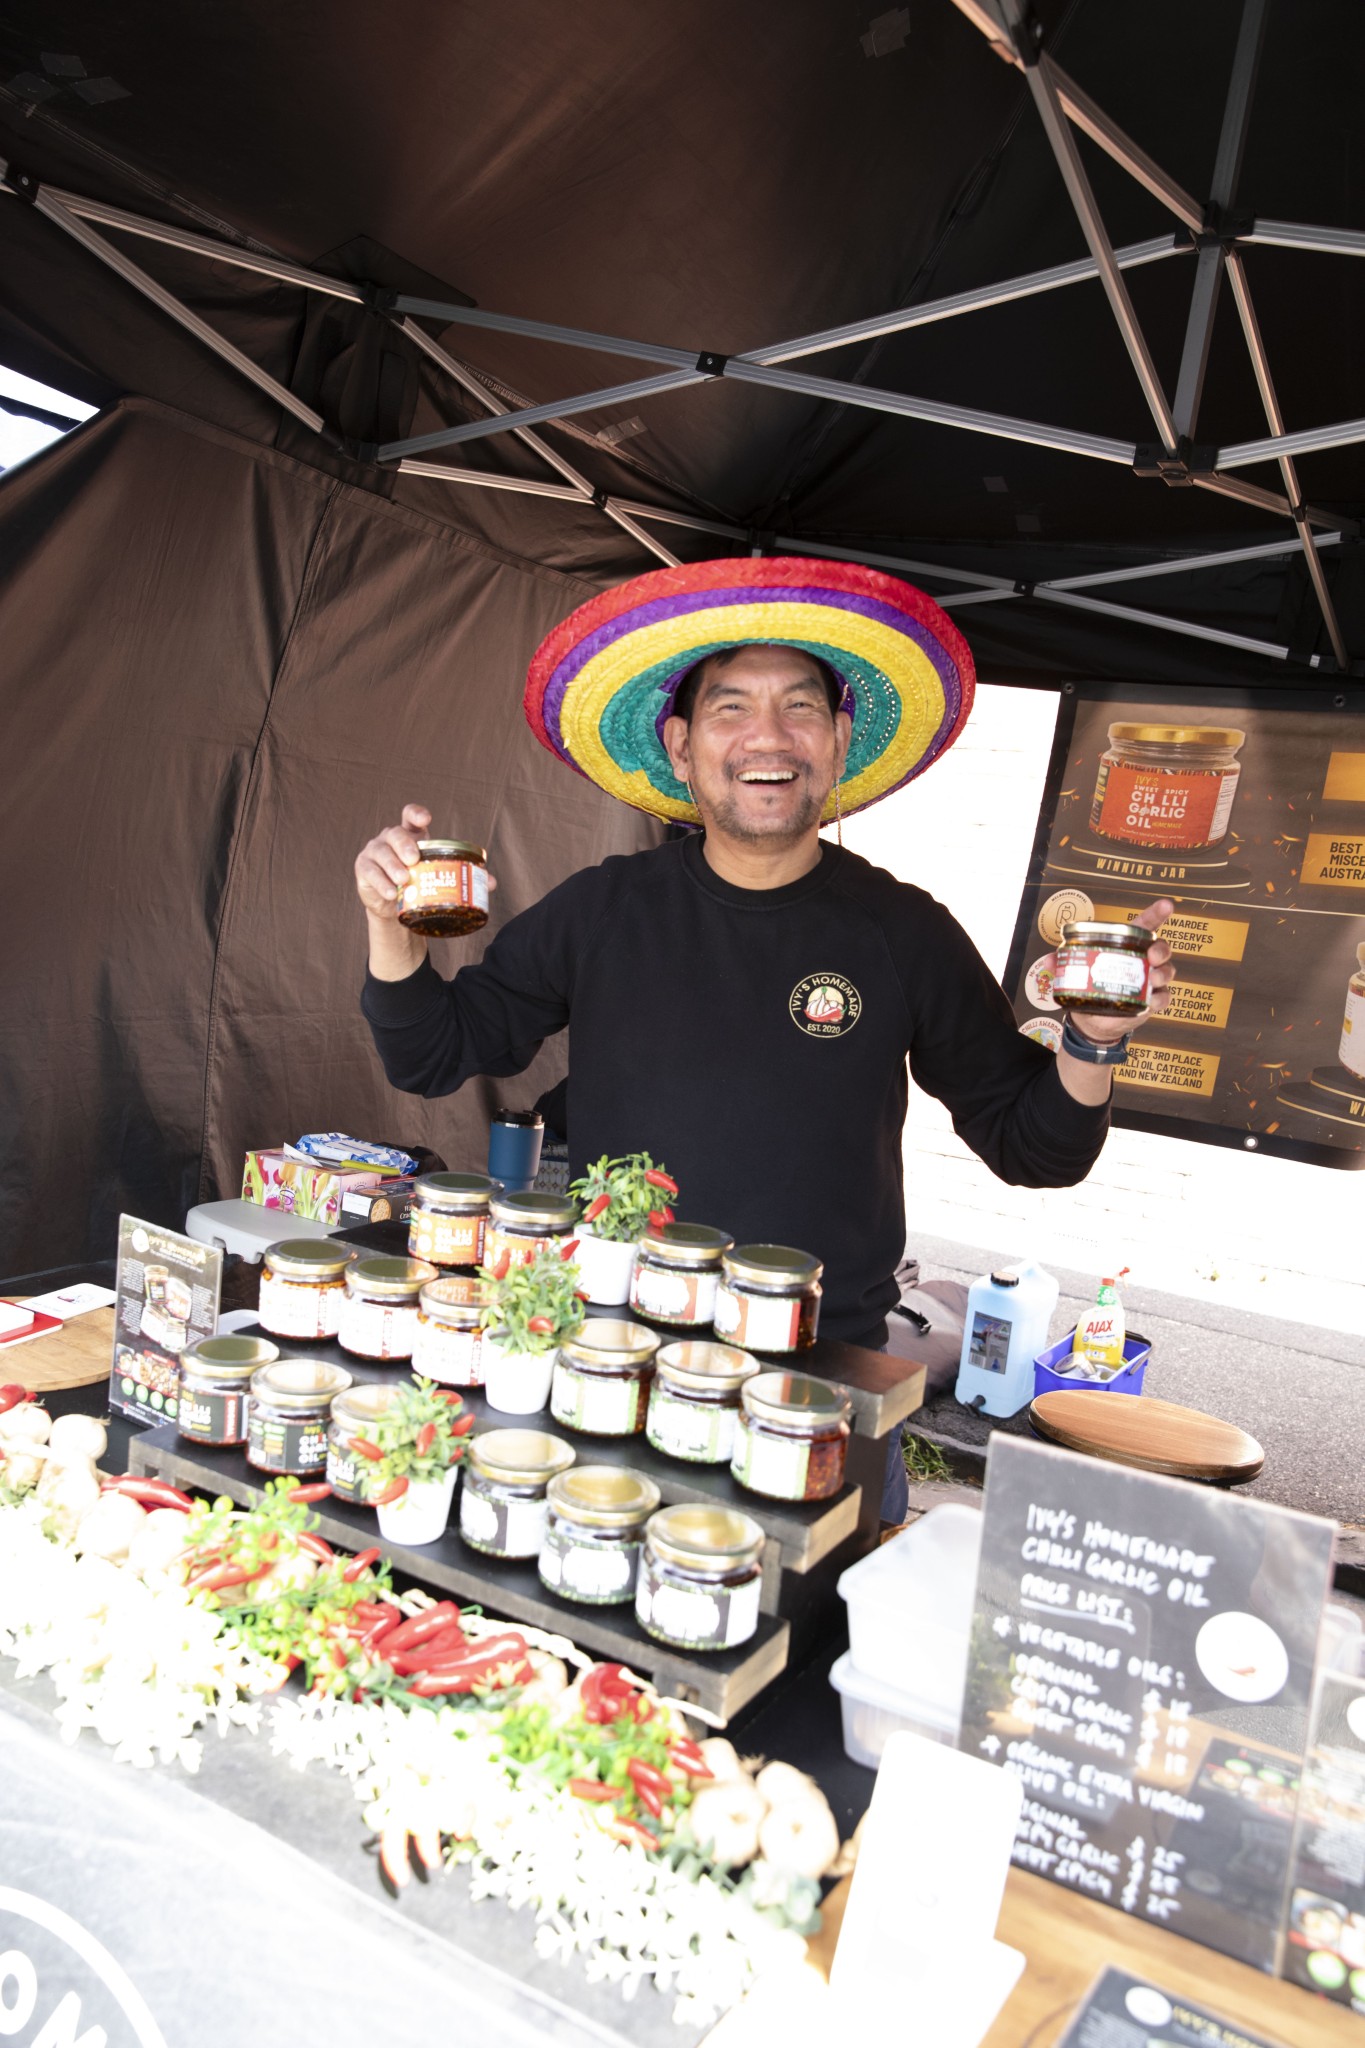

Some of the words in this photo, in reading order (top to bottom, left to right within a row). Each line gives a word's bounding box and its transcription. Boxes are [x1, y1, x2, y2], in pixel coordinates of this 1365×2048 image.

[1134, 784, 1159, 793] SWEET
[1165, 788, 1189, 796] SPICY
[1136, 775, 1159, 787] IVY'S
[1126, 814, 1151, 829] OIL
[1330, 842, 1363, 854] BEST
[1096, 858, 1153, 877] WINNING
[1160, 867, 1187, 879] JAR
[1164, 917, 1209, 931] AWARDEE
[1160, 928, 1213, 944] PRESERVES
[1168, 940, 1203, 953] TEGORY
[792, 983, 811, 1011] IVY'S
[811, 976, 858, 1018] HOMEMADE
[1184, 988, 1215, 1001] PLACE
[1170, 998, 1213, 1012] ATEGORY
[1173, 1008, 1217, 1023] ZEALAND
[822, 1024, 841, 1034] 2020
[1129, 1047, 1152, 1059] BEST
[1152, 1051, 1171, 1062] 3RD
[1172, 1053, 1203, 1067] PLACE
[1118, 1068, 1137, 1079] AND
[1138, 1070, 1159, 1081] NEW
[1160, 1074, 1203, 1089] ZEALAND
[1141, 1060, 1154, 1071] OIL
[1156, 1063, 1205, 1079] CATEGORY
[1085, 1319, 1114, 1336] AJAX
[1026, 1503, 1078, 1540] IVY'S
[1082, 1520, 1217, 1578] HOMEMADE
[1021, 1536, 1083, 1571] CHILLI
[1084, 1552, 1161, 1595] GARLIC
[1166, 1577, 1211, 1608] OIL
[1021, 1572, 1071, 1605] PRICE
[1018, 1619, 1122, 1669] VEGETABLE
[1072, 1695, 1133, 1734] GARLIC
[1078, 1763, 1134, 1804] EXTRA
[1138, 1784, 1205, 1822] VIRGIN
[1055, 1835, 1121, 1875] GARLIC
